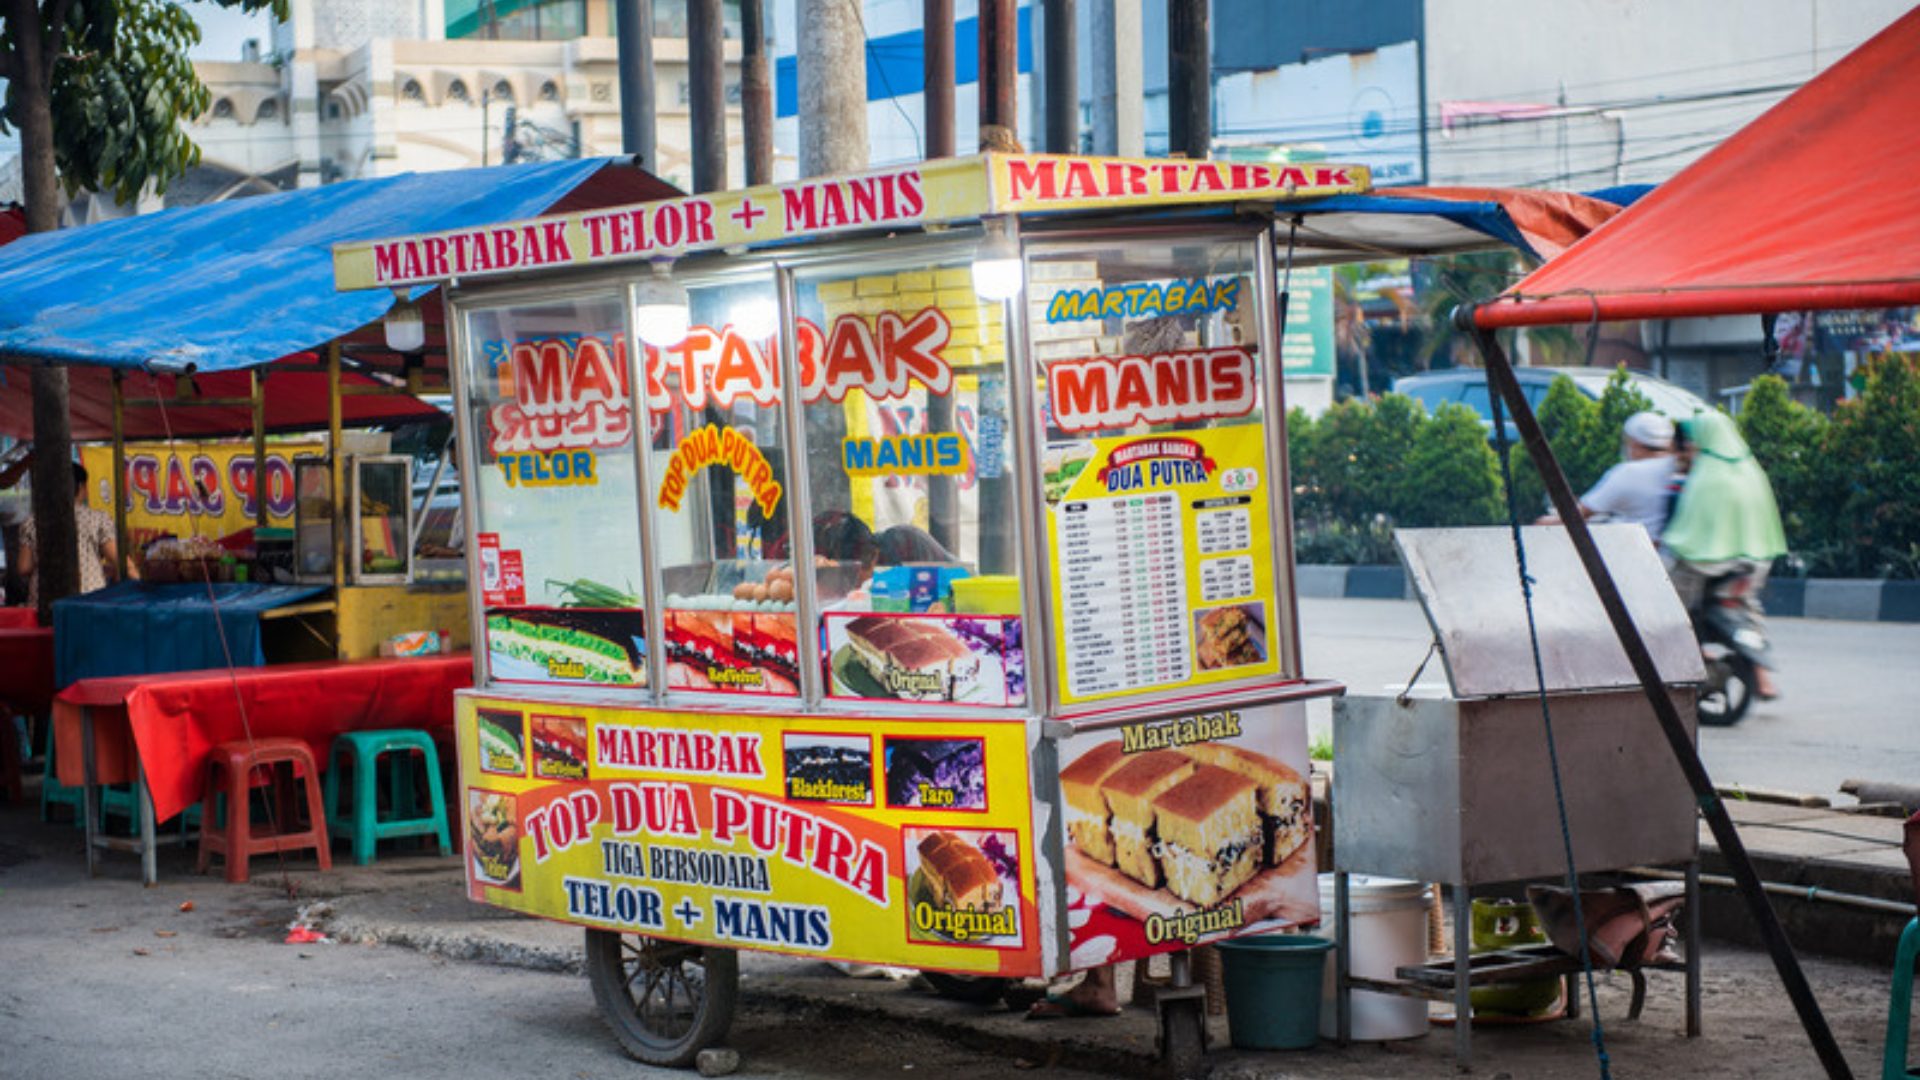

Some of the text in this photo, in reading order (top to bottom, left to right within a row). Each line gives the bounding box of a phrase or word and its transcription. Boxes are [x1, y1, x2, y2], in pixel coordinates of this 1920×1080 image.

[1008, 160, 1354, 201] MARTABAK
[373, 171, 925, 283] MARTABAK TELOR + MANIS
[1047, 279, 1240, 322] MARTABAK
[513, 308, 950, 410] MARTABAK
[1051, 349, 1250, 425] MANIS
[500, 451, 595, 483] TELOR
[658, 422, 783, 520] TOP DUA PUTRA
[844, 434, 965, 472] MANIS
[1107, 463, 1144, 492] DUA
[1151, 460, 1209, 486] PUTRA
[889, 669, 943, 695] Original
[596, 726, 762, 775] MARTABAK
[1121, 711, 1241, 752] Martabak
[791, 777, 866, 802] Blackforest
[919, 784, 954, 805] Taro
[526, 786, 888, 904] TOP DUA PUTRA
[602, 841, 771, 892] TIGA BERSODARA
[564, 879, 830, 948] TELOR + MANIS
[915, 902, 1018, 940] Original
[1144, 898, 1244, 945] Original
